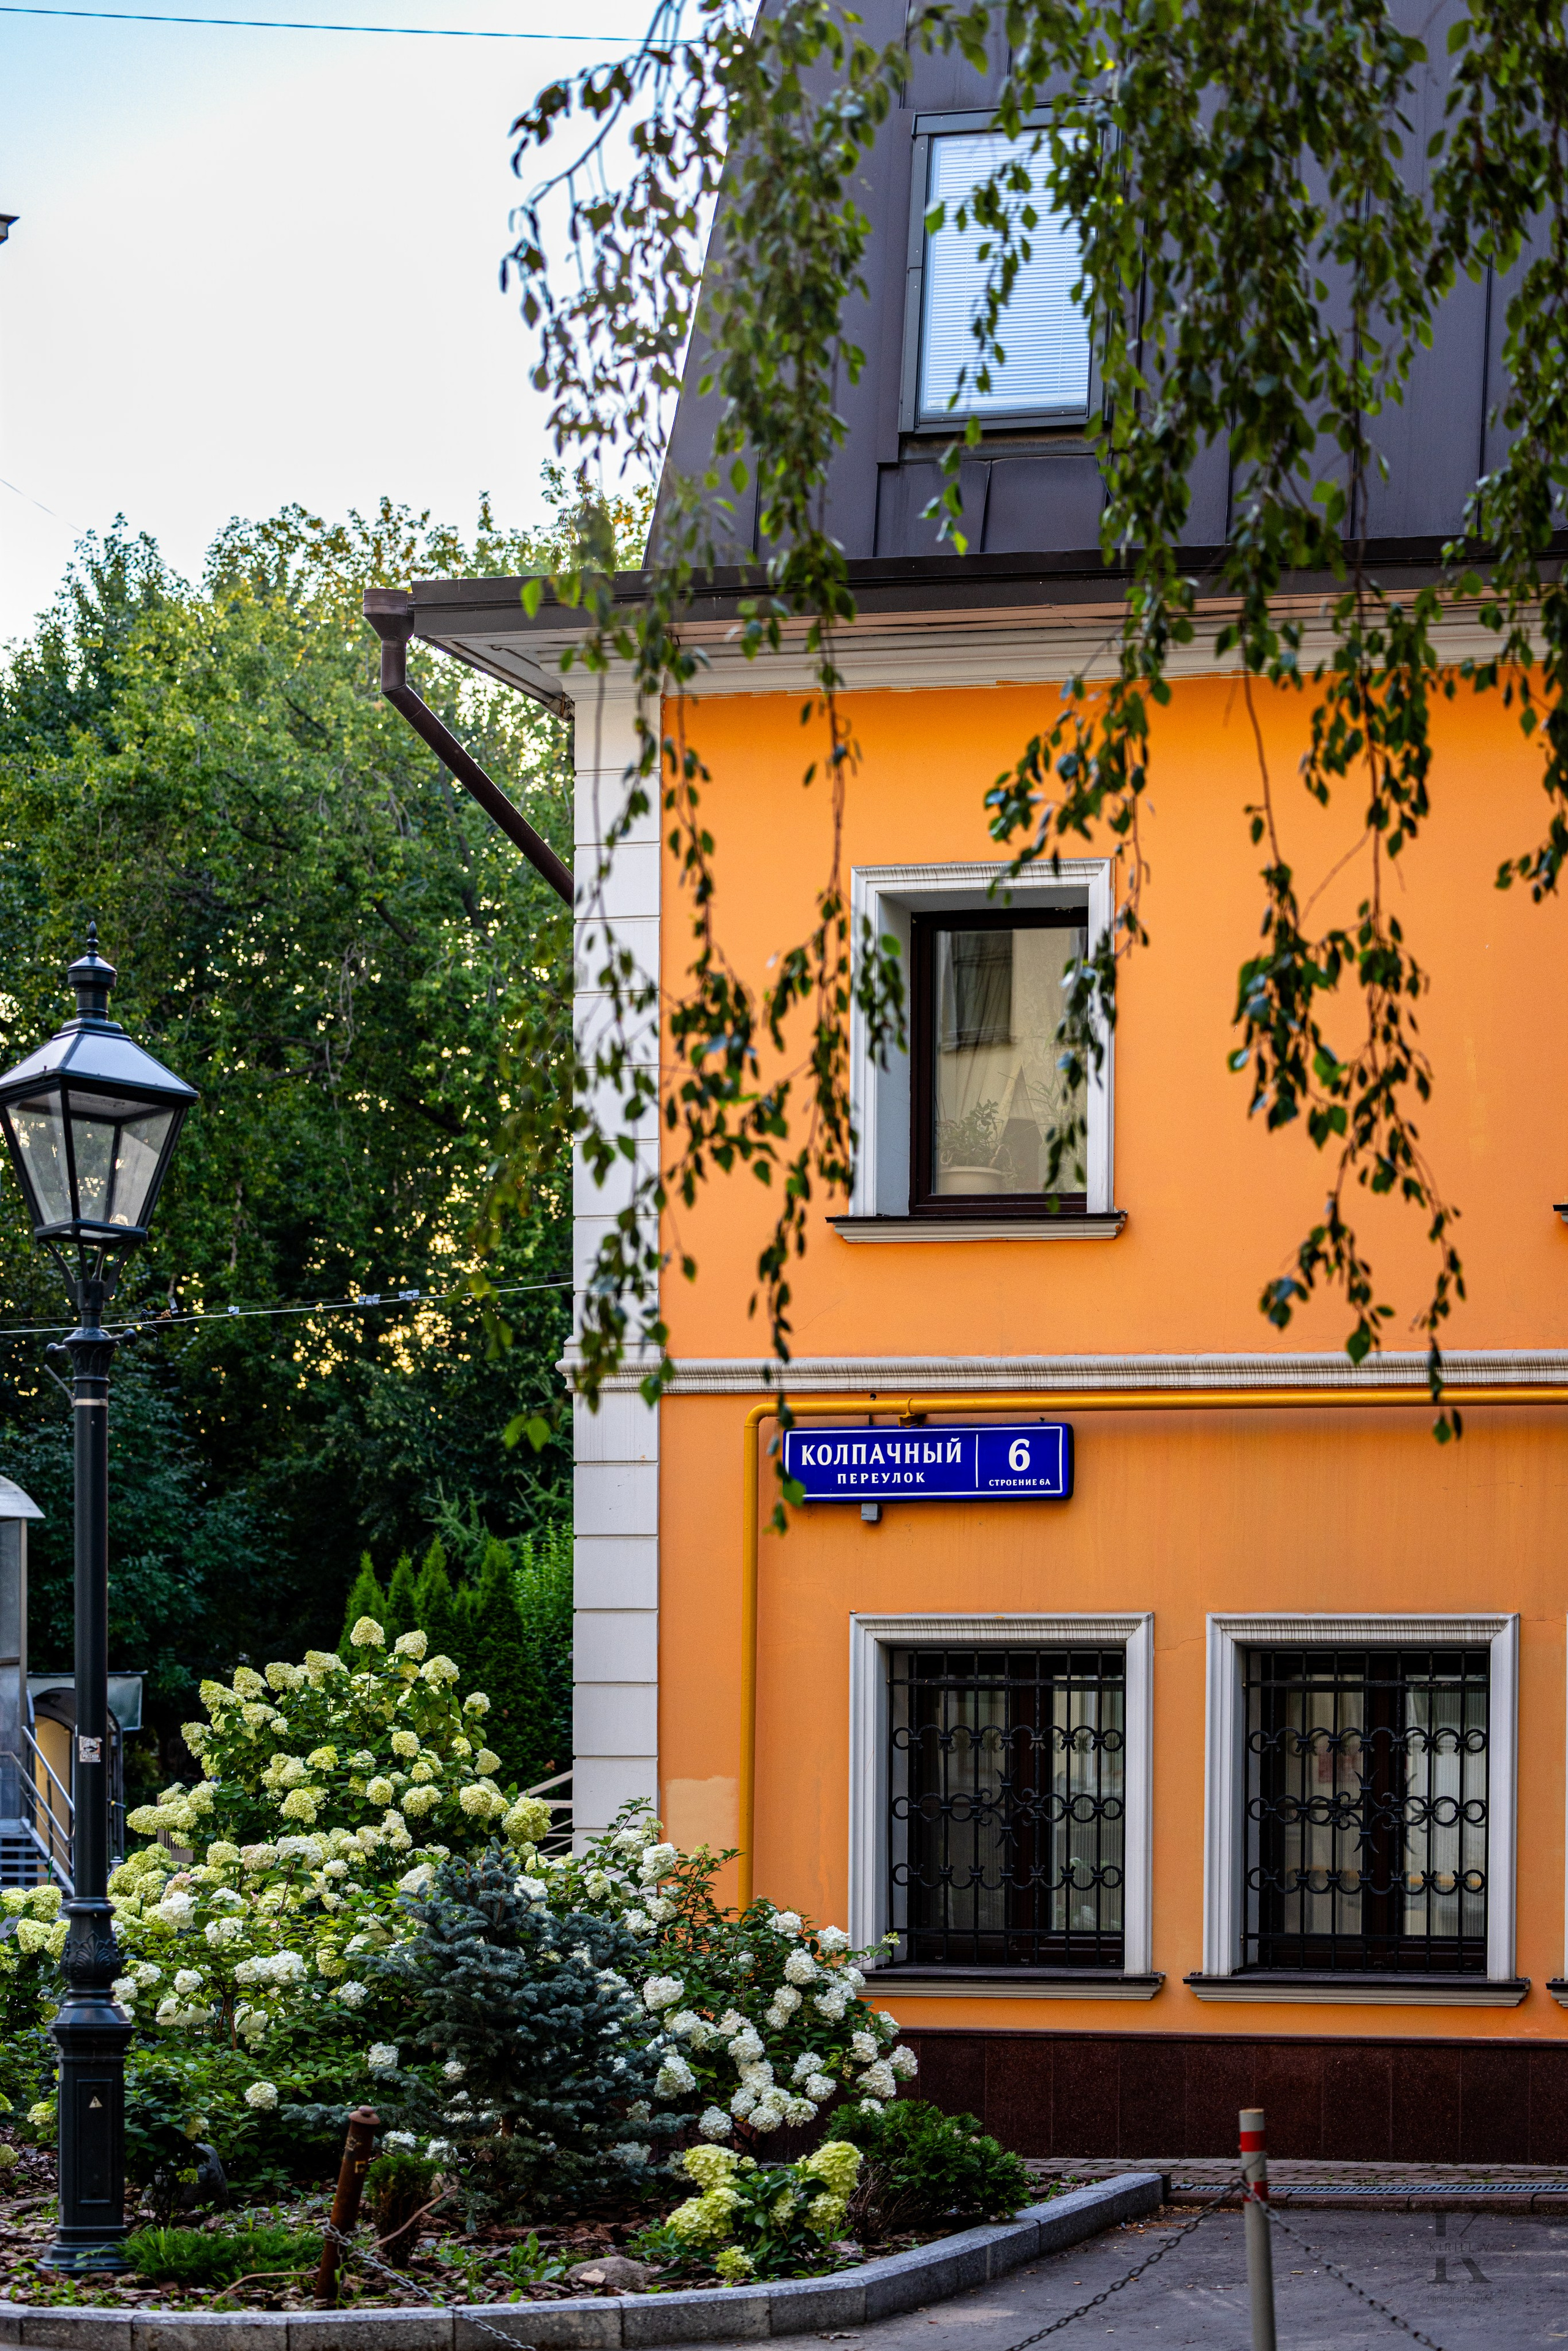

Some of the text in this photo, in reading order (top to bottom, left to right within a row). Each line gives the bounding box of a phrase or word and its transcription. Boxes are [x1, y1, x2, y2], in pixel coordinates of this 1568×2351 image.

[801, 1437, 962, 1466] КОЛПАЧНЫЙ
[1008, 1438, 1030, 1471] 6
[837, 1472, 925, 1484] ПЕРЕУЛОК
